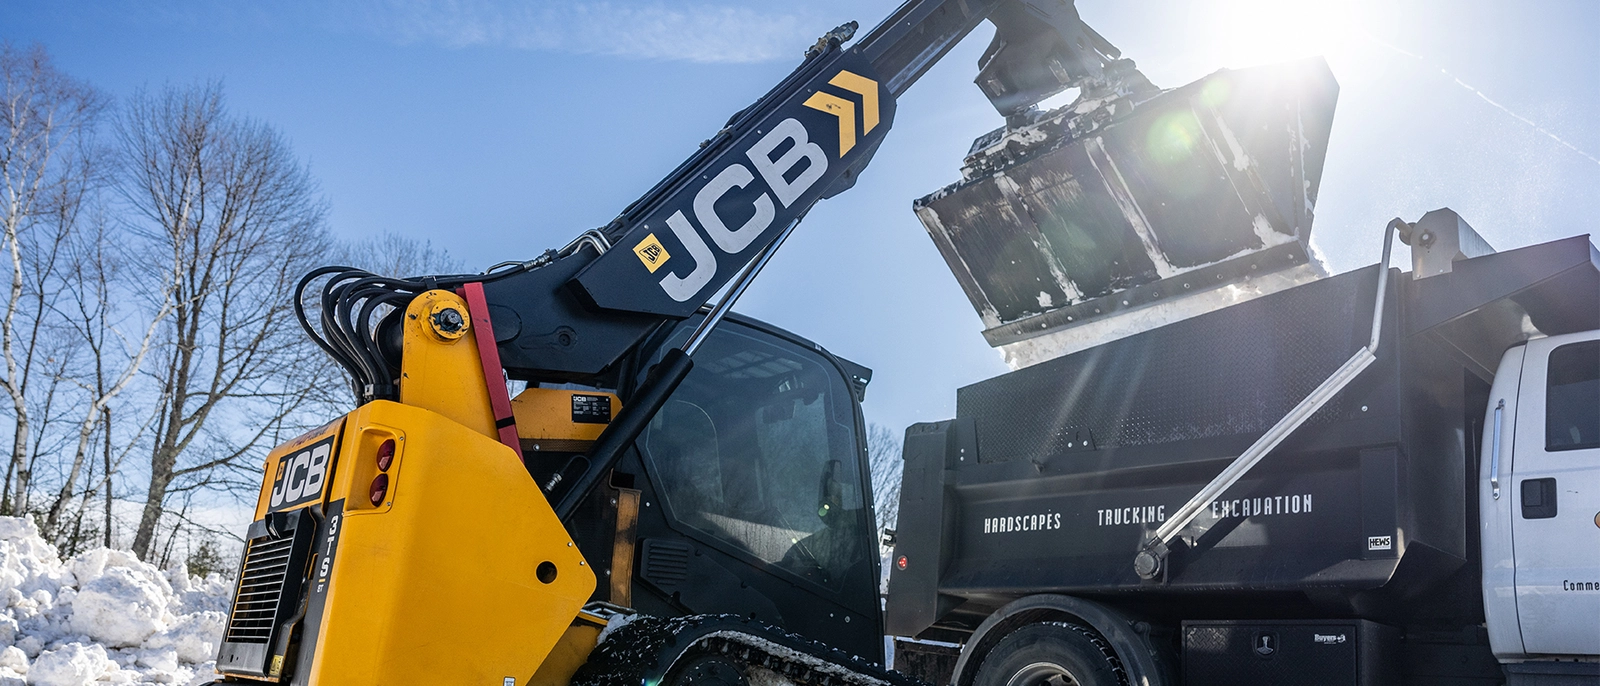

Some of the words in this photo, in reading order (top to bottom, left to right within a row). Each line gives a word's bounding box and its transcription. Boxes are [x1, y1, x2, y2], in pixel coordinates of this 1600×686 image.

[659, 117, 829, 302] JCB
[643, 244, 660, 262] JCB
[271, 443, 330, 508] JCB
[984, 513, 1061, 534] HARDSCAPES
[1098, 505, 1166, 527] TRUCKING
[1212, 494, 1313, 519] EXCAVATION
[319, 515, 339, 577] 3TS
[1369, 537, 1390, 548] HEWS
[1563, 579, 1600, 591] Comme
